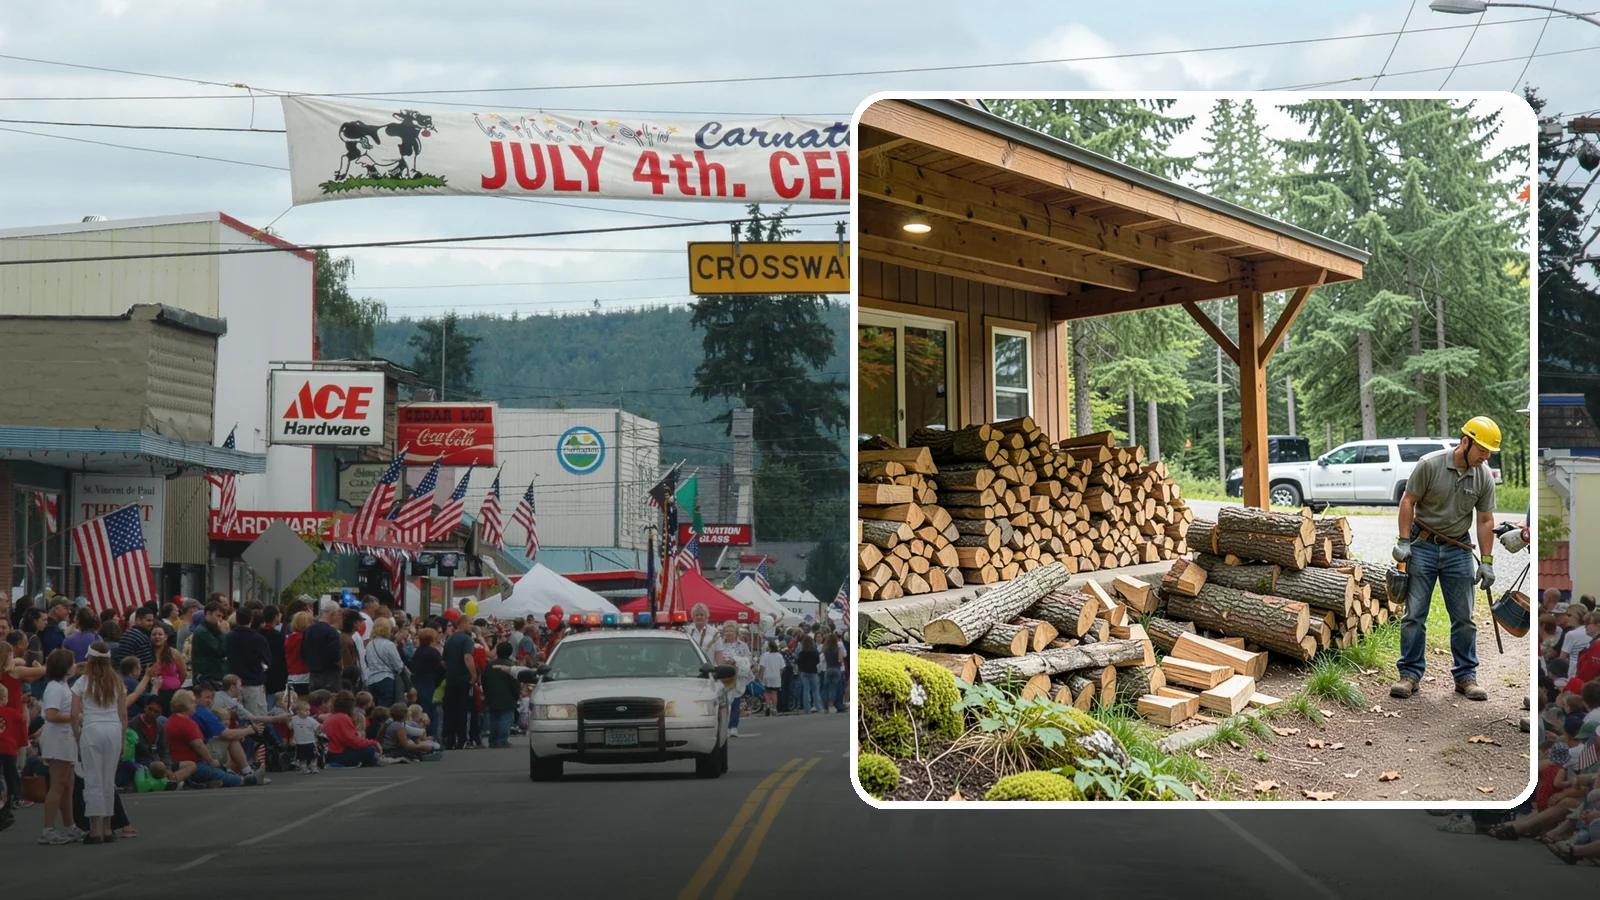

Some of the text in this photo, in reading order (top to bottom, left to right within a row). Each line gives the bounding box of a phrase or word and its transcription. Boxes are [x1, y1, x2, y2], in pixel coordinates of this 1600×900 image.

[481, 141, 604, 192] JULY
[632, 150, 746, 198] 4th.
[697, 255, 849, 280] CROSSWA
[283, 380, 374, 419] ACE
[405, 409, 452, 421] CEDAR
[283, 421, 371, 436] Hardware
[416, 428, 477, 446] Coca-Cola
[353, 467, 385, 479] Simpl
[83, 484, 155, 495] St. Vincent de Paul
[80, 503, 154, 521] THT
[688, 526, 741, 535] CRNATION
[699, 535, 730, 543] GLASS
